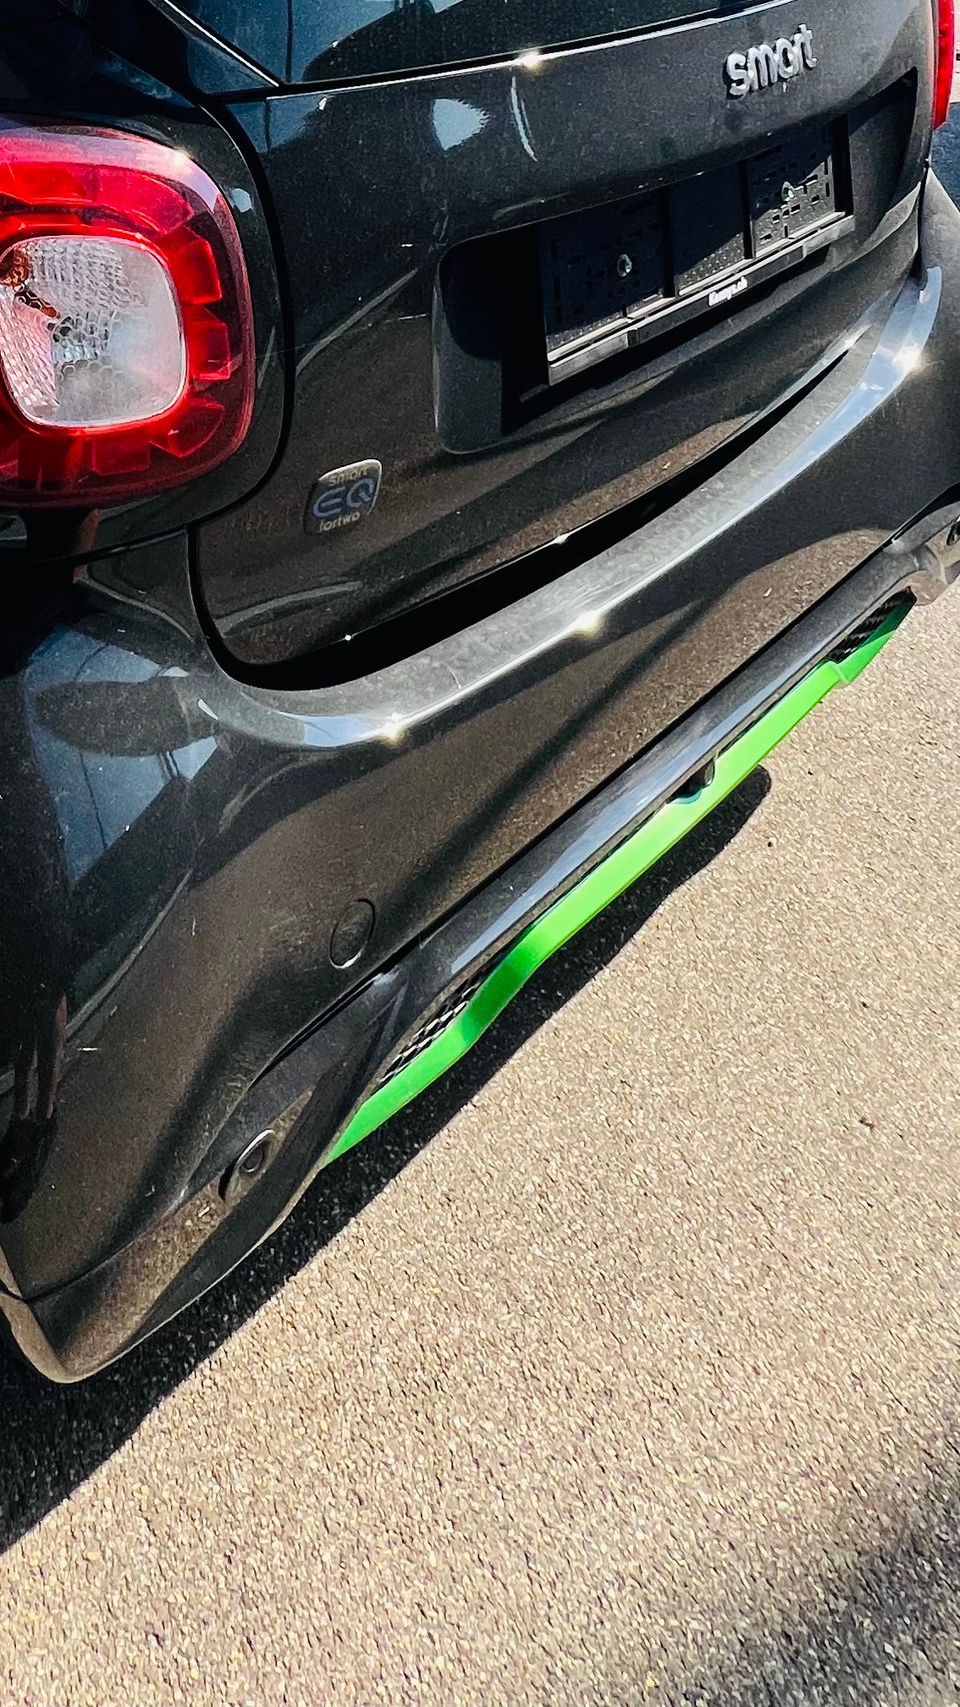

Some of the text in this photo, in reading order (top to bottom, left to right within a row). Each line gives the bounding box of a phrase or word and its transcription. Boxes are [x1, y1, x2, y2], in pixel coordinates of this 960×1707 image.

[725, 23, 818, 96] smart
[327, 467, 368, 486] smart
[312, 478, 374, 518] EQ
[318, 511, 360, 533] fortwo
